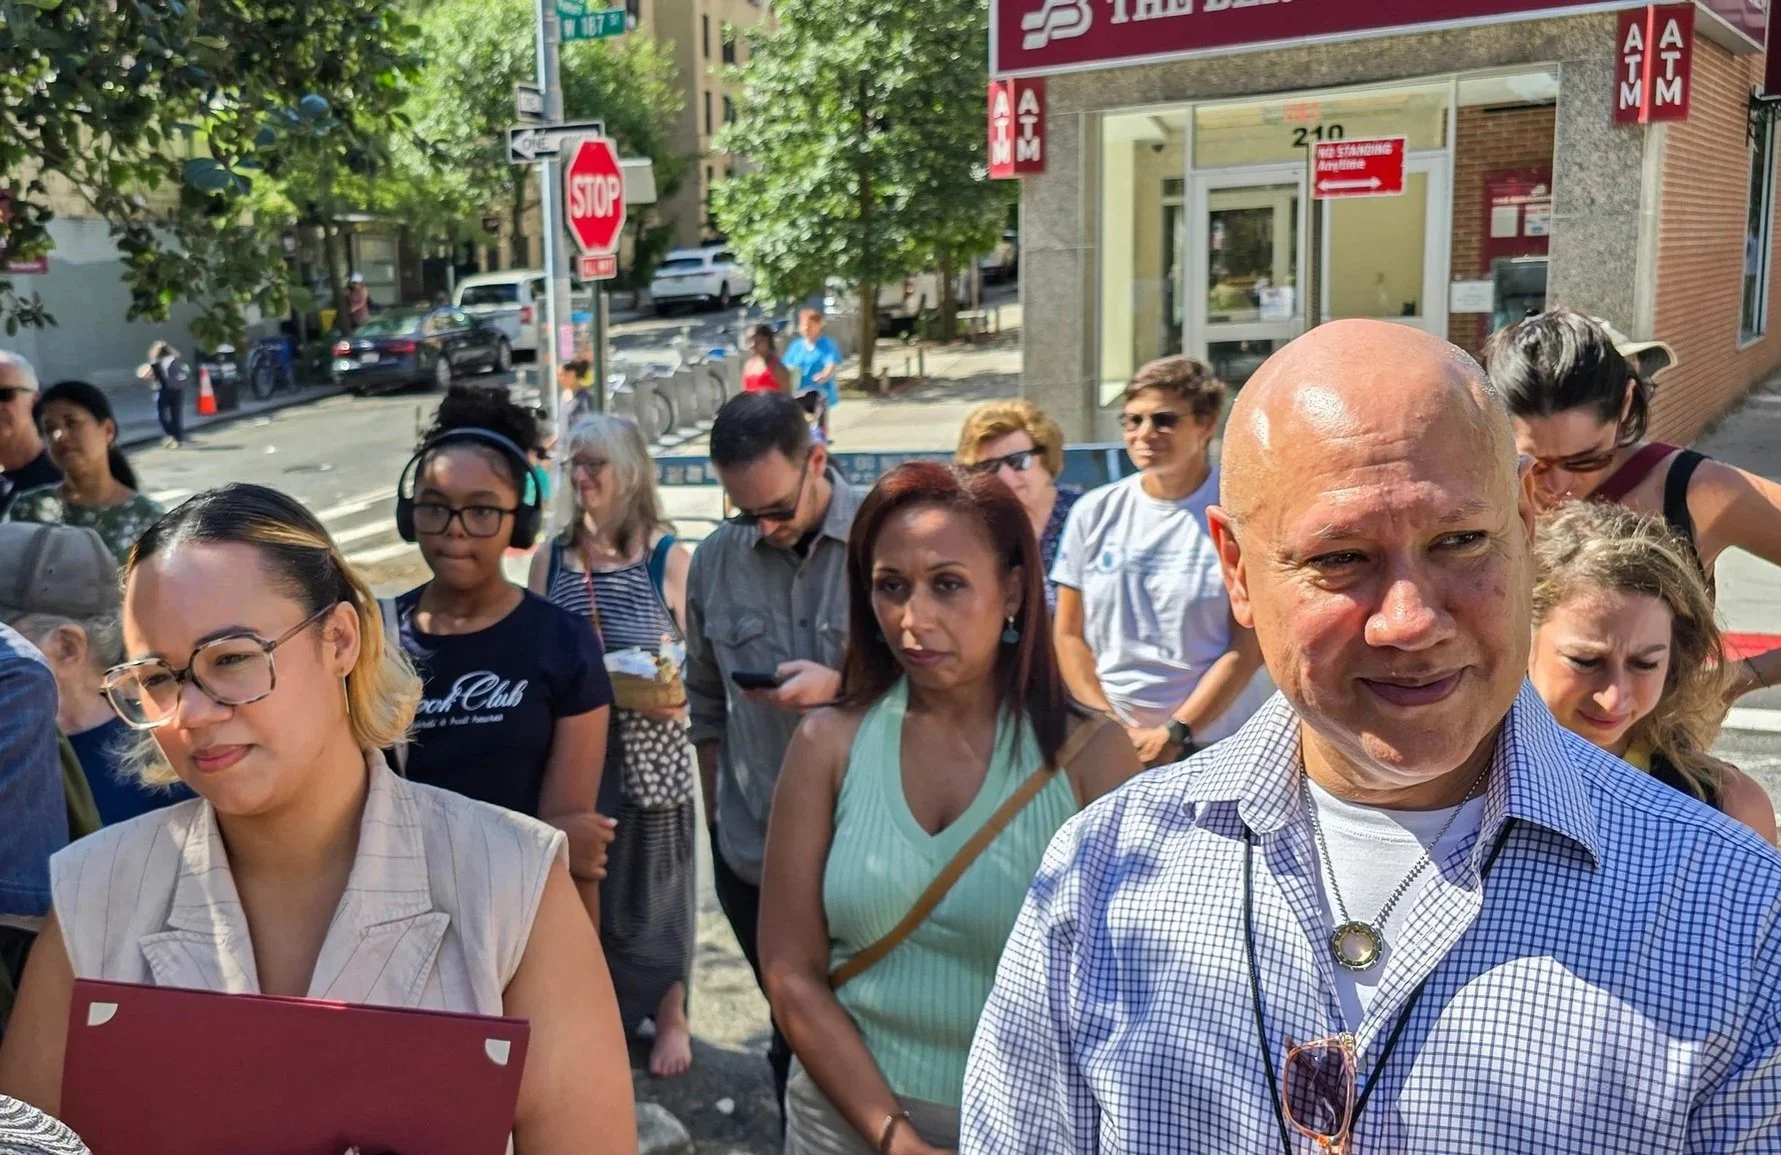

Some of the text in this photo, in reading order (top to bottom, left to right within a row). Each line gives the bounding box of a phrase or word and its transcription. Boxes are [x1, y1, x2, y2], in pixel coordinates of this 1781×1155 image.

[1620, 22, 1643, 110] ATM
[1655, 18, 1683, 106] ATM
[992, 90, 1011, 166] ATM
[1017, 87, 1040, 162] ATM
[1293, 124, 1344, 147] 210
[1318, 141, 1392, 158] NO STANDING
[1318, 158, 1366, 172] Anytime
[571, 174, 620, 219] STOP
[455, 670, 528, 711] Club
